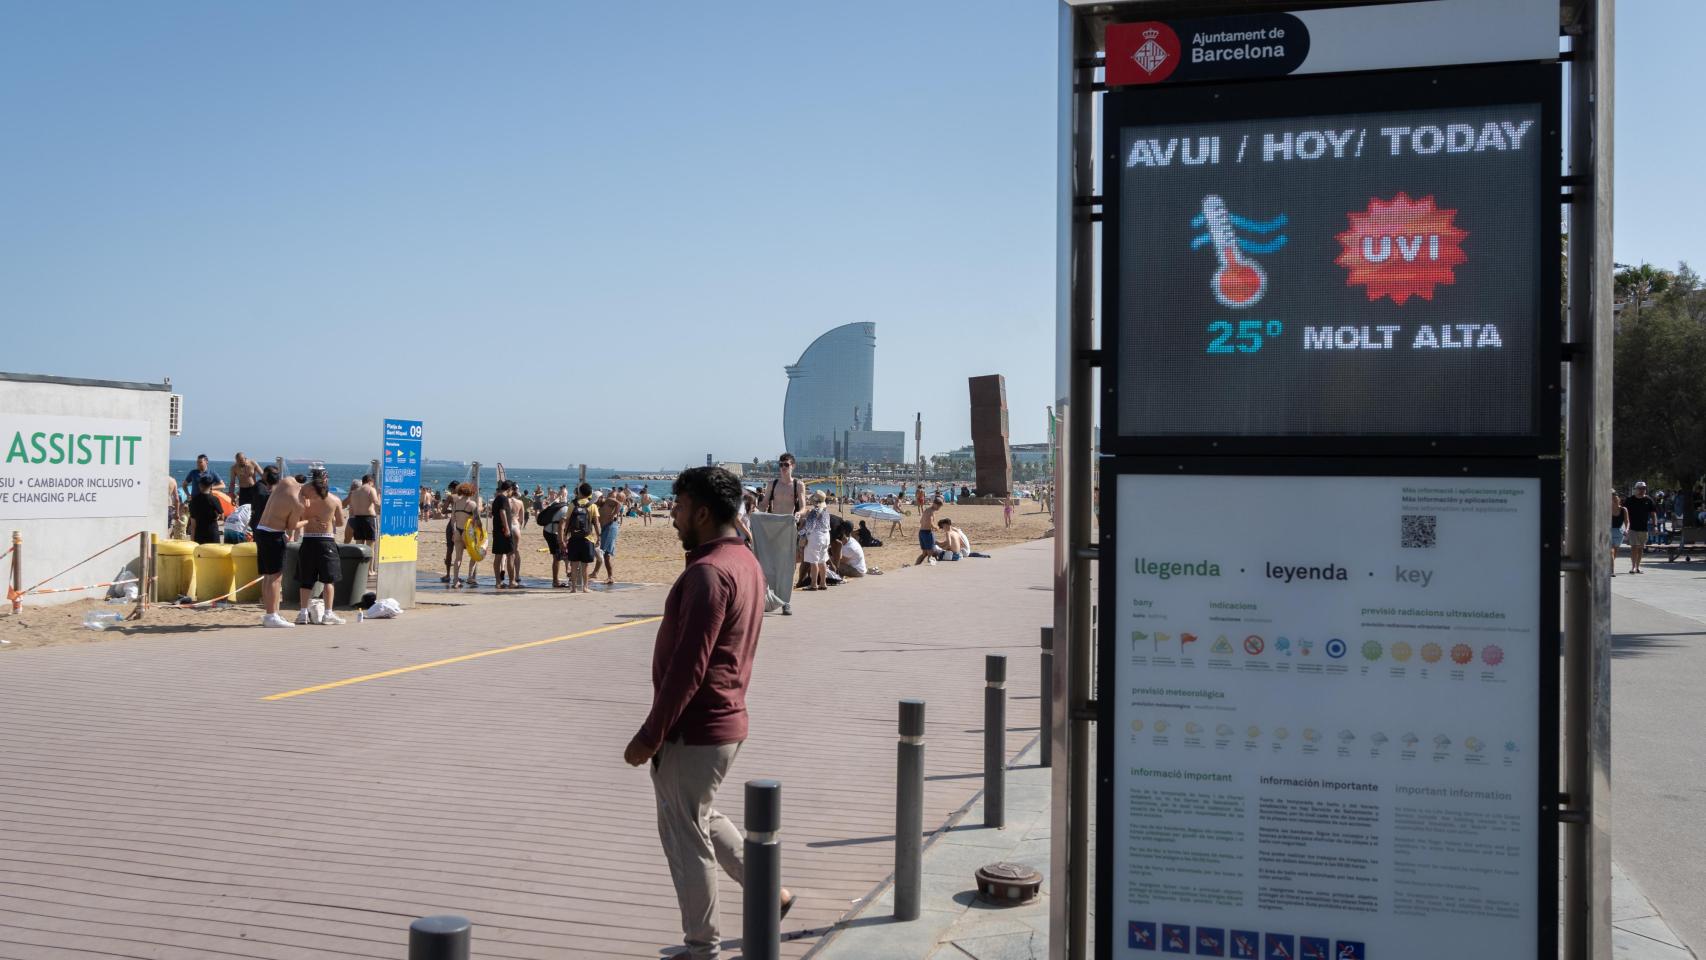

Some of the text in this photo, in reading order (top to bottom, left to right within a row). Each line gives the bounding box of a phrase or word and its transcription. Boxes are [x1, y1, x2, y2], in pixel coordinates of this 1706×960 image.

[1192, 27, 1285, 45] Ajuntament de
[1192, 43, 1285, 63] Barcelona
[1126, 136, 1220, 168] AVUI
[1382, 120, 1535, 155] TODAY
[1363, 235, 1440, 262] UVI
[1303, 323, 1503, 350] MOLT ALTA
[409, 425, 422, 438] 09
[6, 431, 142, 465] ASSISTIT
[27, 477, 84, 488] CAMBIADOR
[87, 478, 134, 488] INCLUSIVO
[12, 492, 65, 503] CHANGING
[67, 492, 97, 502] PLACE
[1134, 557, 1434, 588] llegenda leyenda key
[1130, 767, 1232, 782] informació important
[1260, 775, 1379, 792] información importante
[1395, 784, 1512, 801] important information
